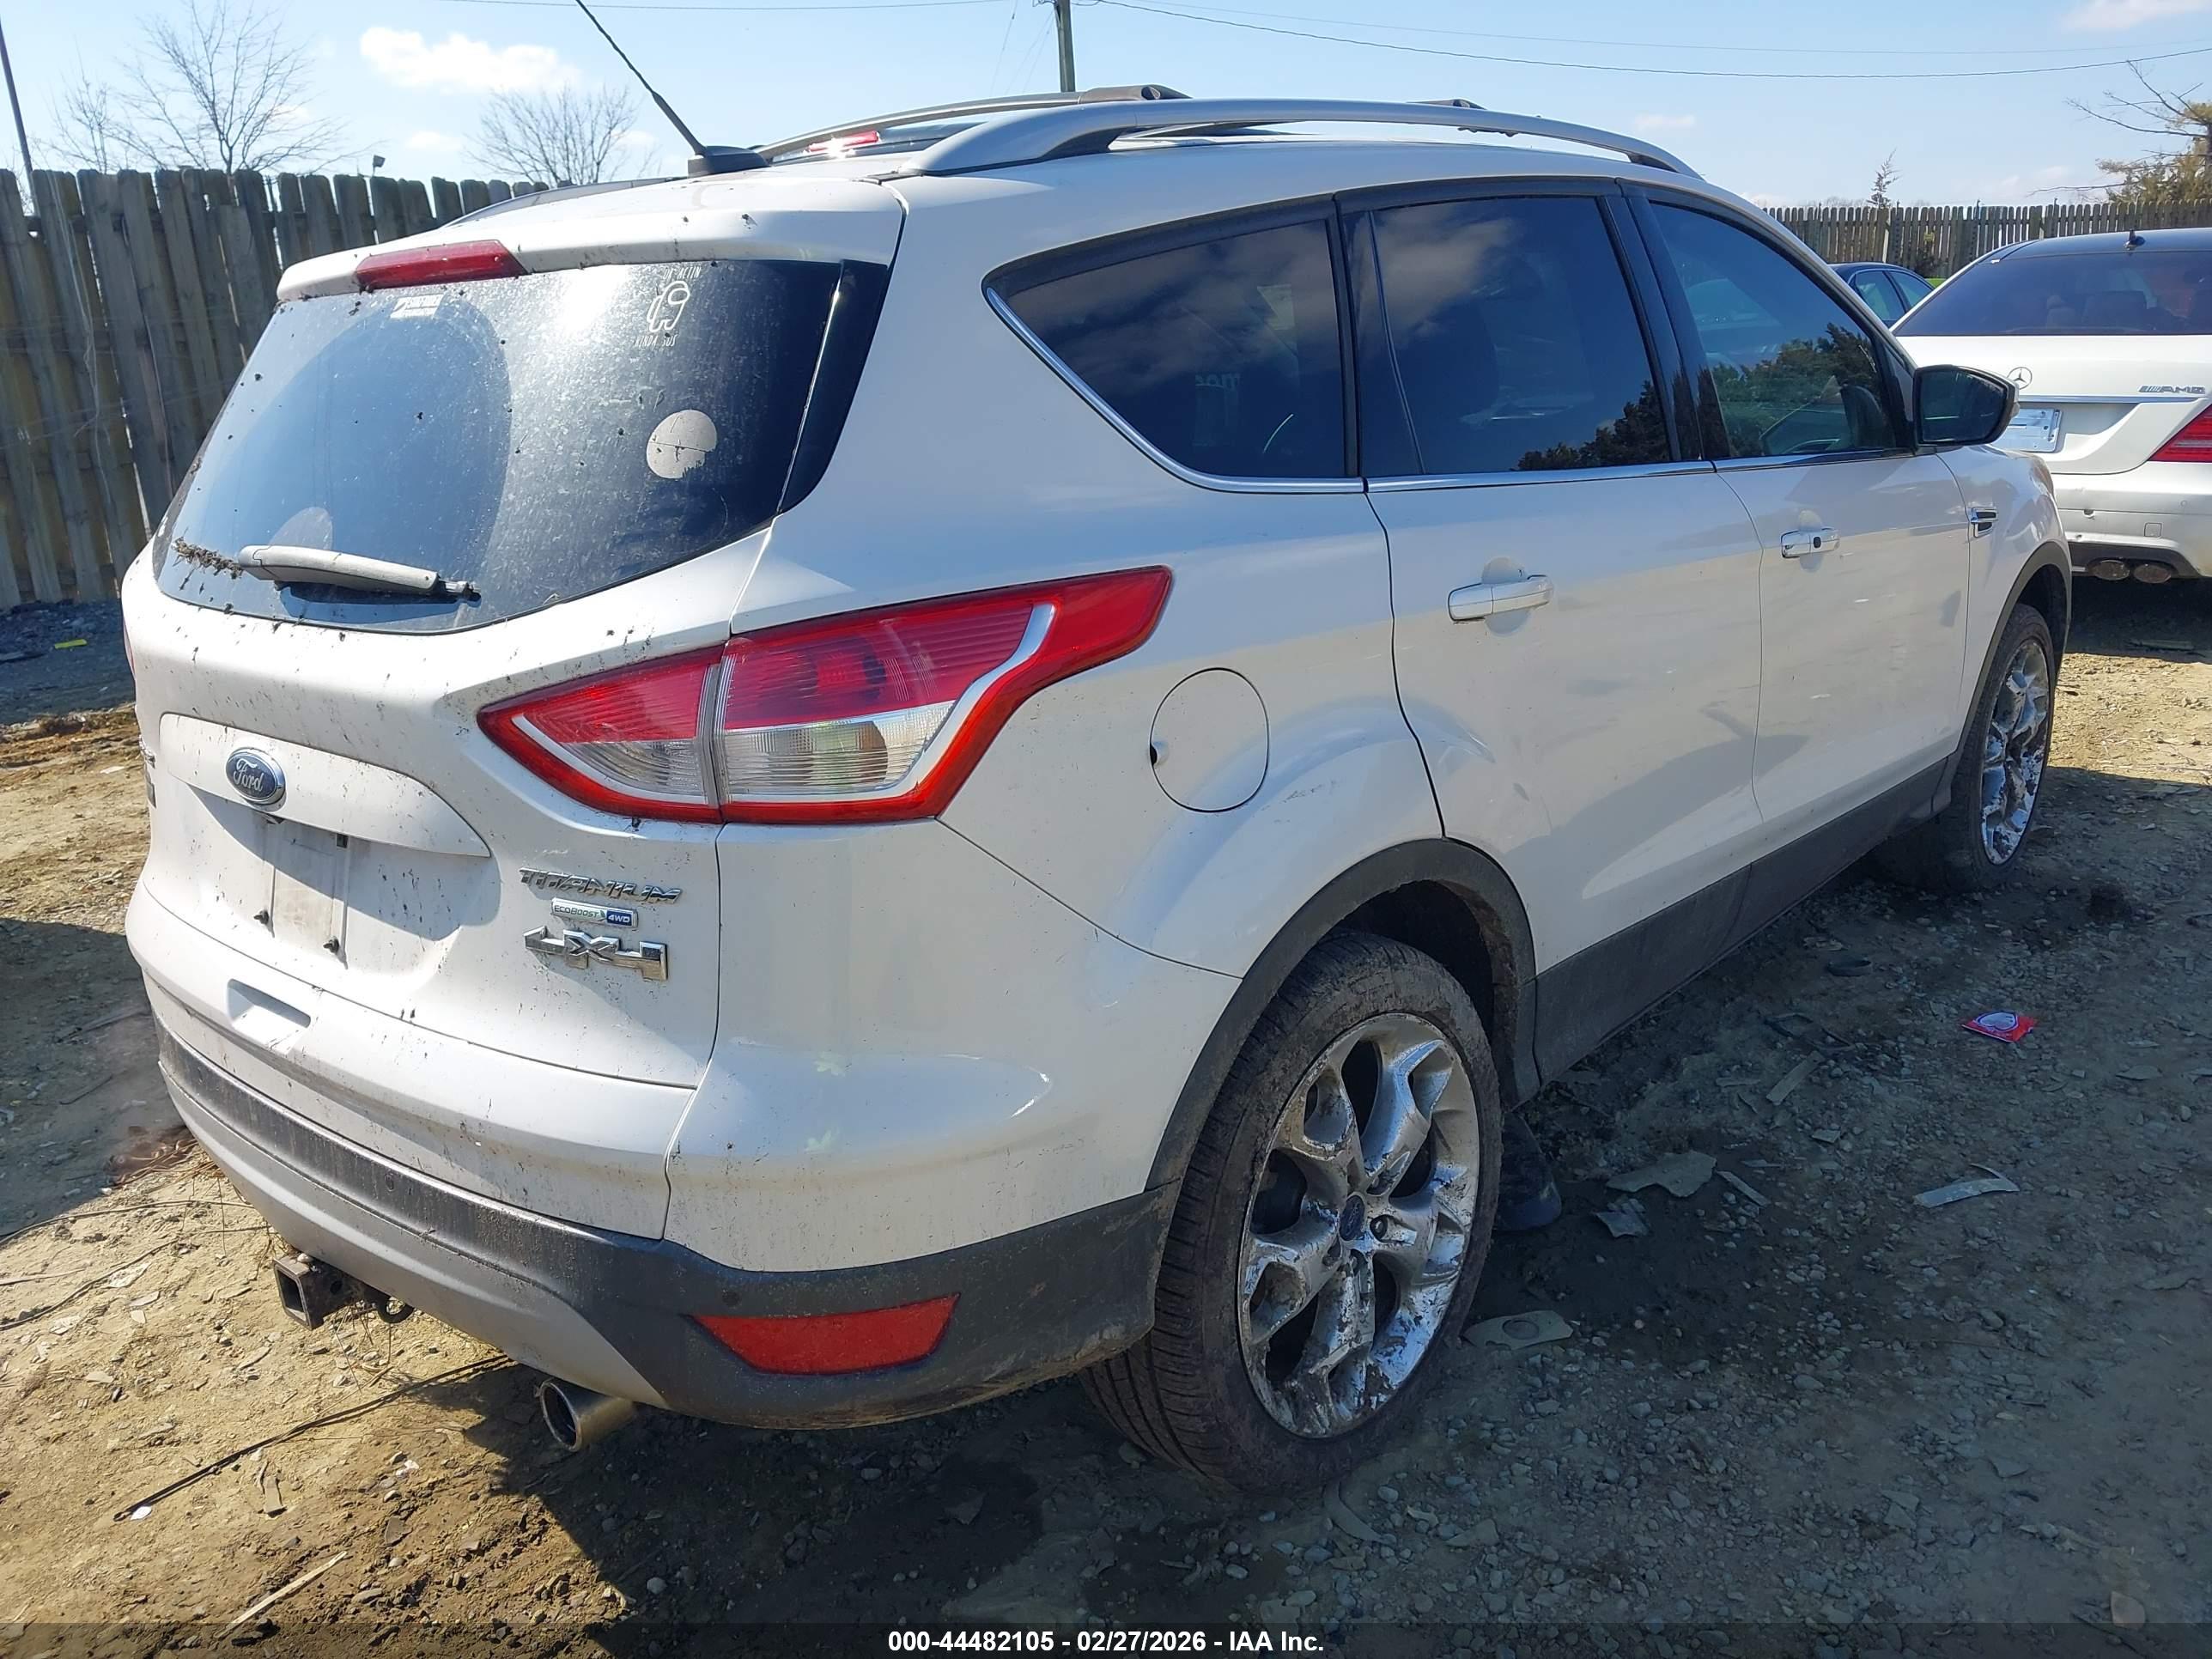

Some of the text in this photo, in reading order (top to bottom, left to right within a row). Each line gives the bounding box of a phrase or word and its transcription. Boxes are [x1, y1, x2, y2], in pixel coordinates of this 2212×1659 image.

[634, 334, 678, 348] KINDA SUS
[2158, 386, 2206, 395] AMG
[233, 757, 264, 793] Ford
[519, 867, 684, 904] TITANIUM
[607, 913, 631, 924] 4WD
